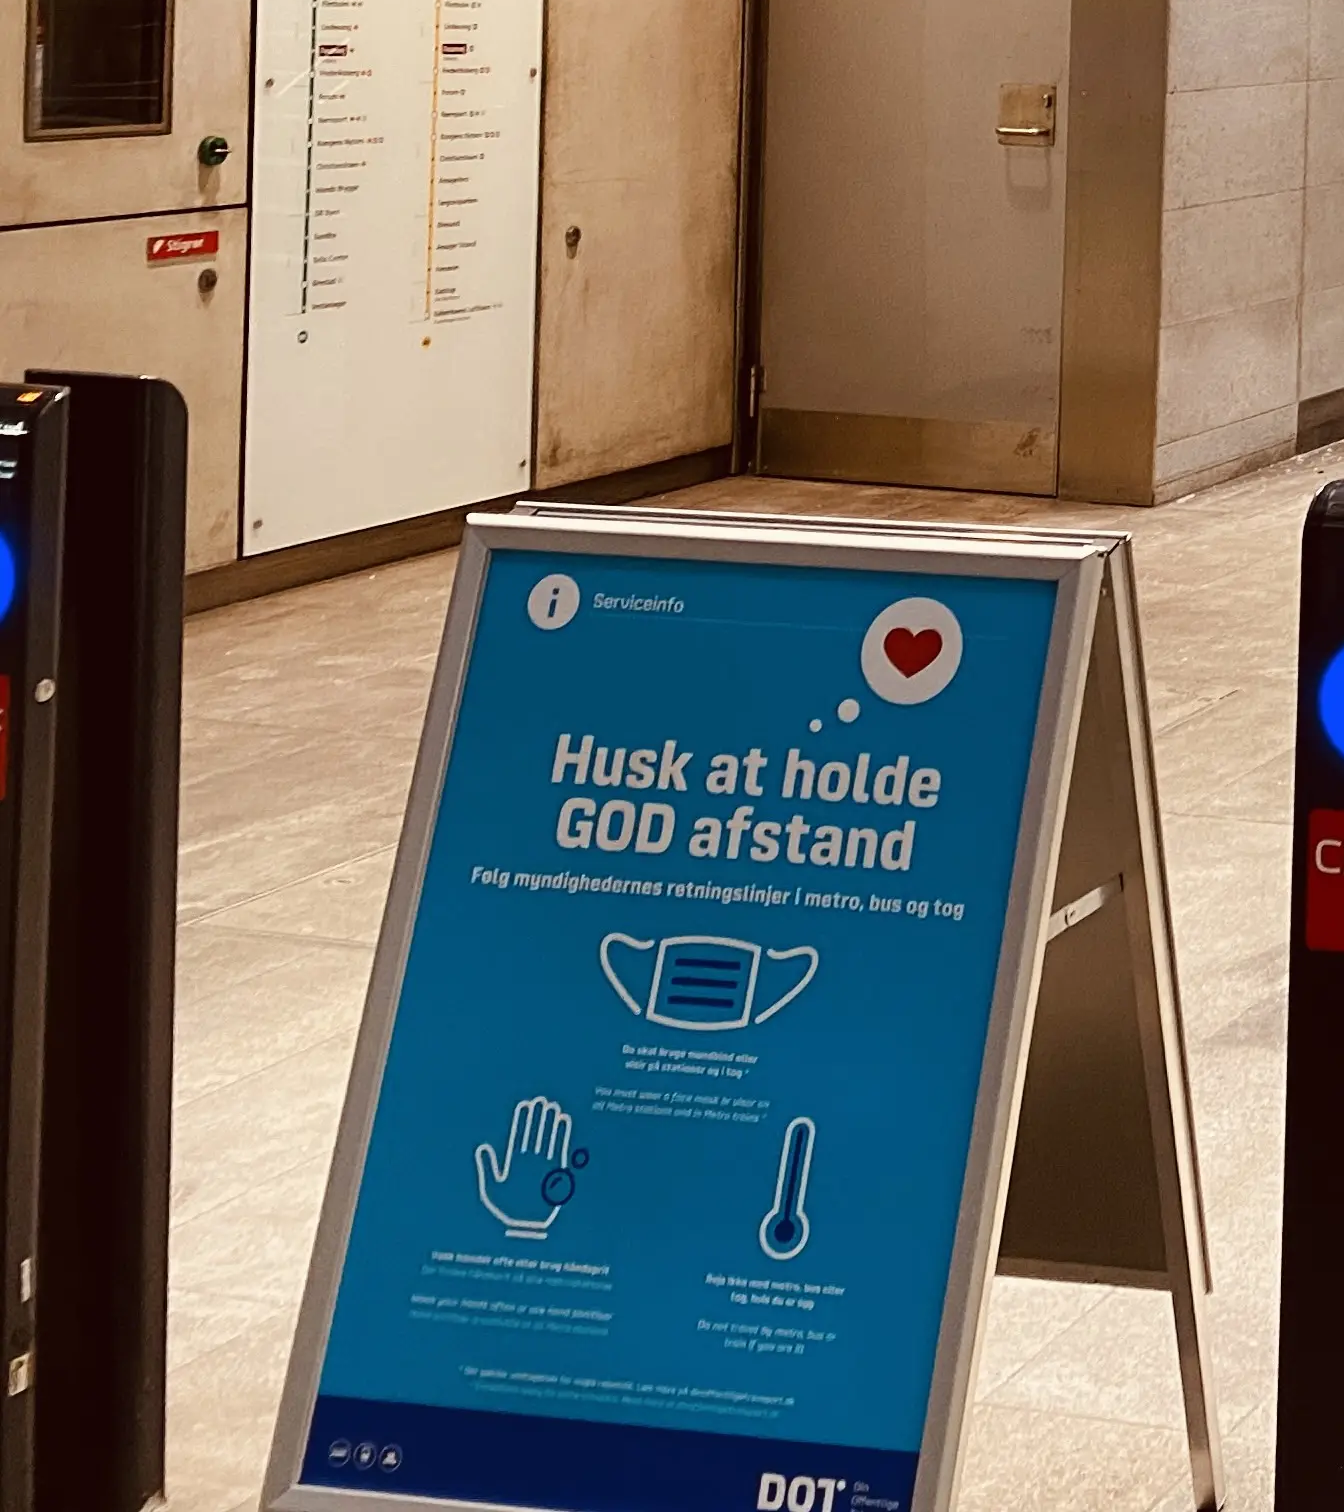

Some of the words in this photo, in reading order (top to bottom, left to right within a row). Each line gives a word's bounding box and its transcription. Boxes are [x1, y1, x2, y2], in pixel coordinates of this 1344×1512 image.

[593, 593, 684, 614] Serviceinfo
[551, 733, 693, 792] Husk
[705, 748, 767, 796] at
[782, 749, 941, 808] holde
[556, 797, 676, 854] GOD
[689, 805, 916, 872] afstand
[471, 867, 510, 889] Følg
[513, 871, 662, 898] myndighedernes
[667, 879, 790, 907] retningslinjer
[804, 891, 865, 914] metro,
[869, 893, 902, 914] bus
[906, 899, 930, 919] og
[933, 898, 966, 921] tog
[757, 1472, 838, 1512] DOT
